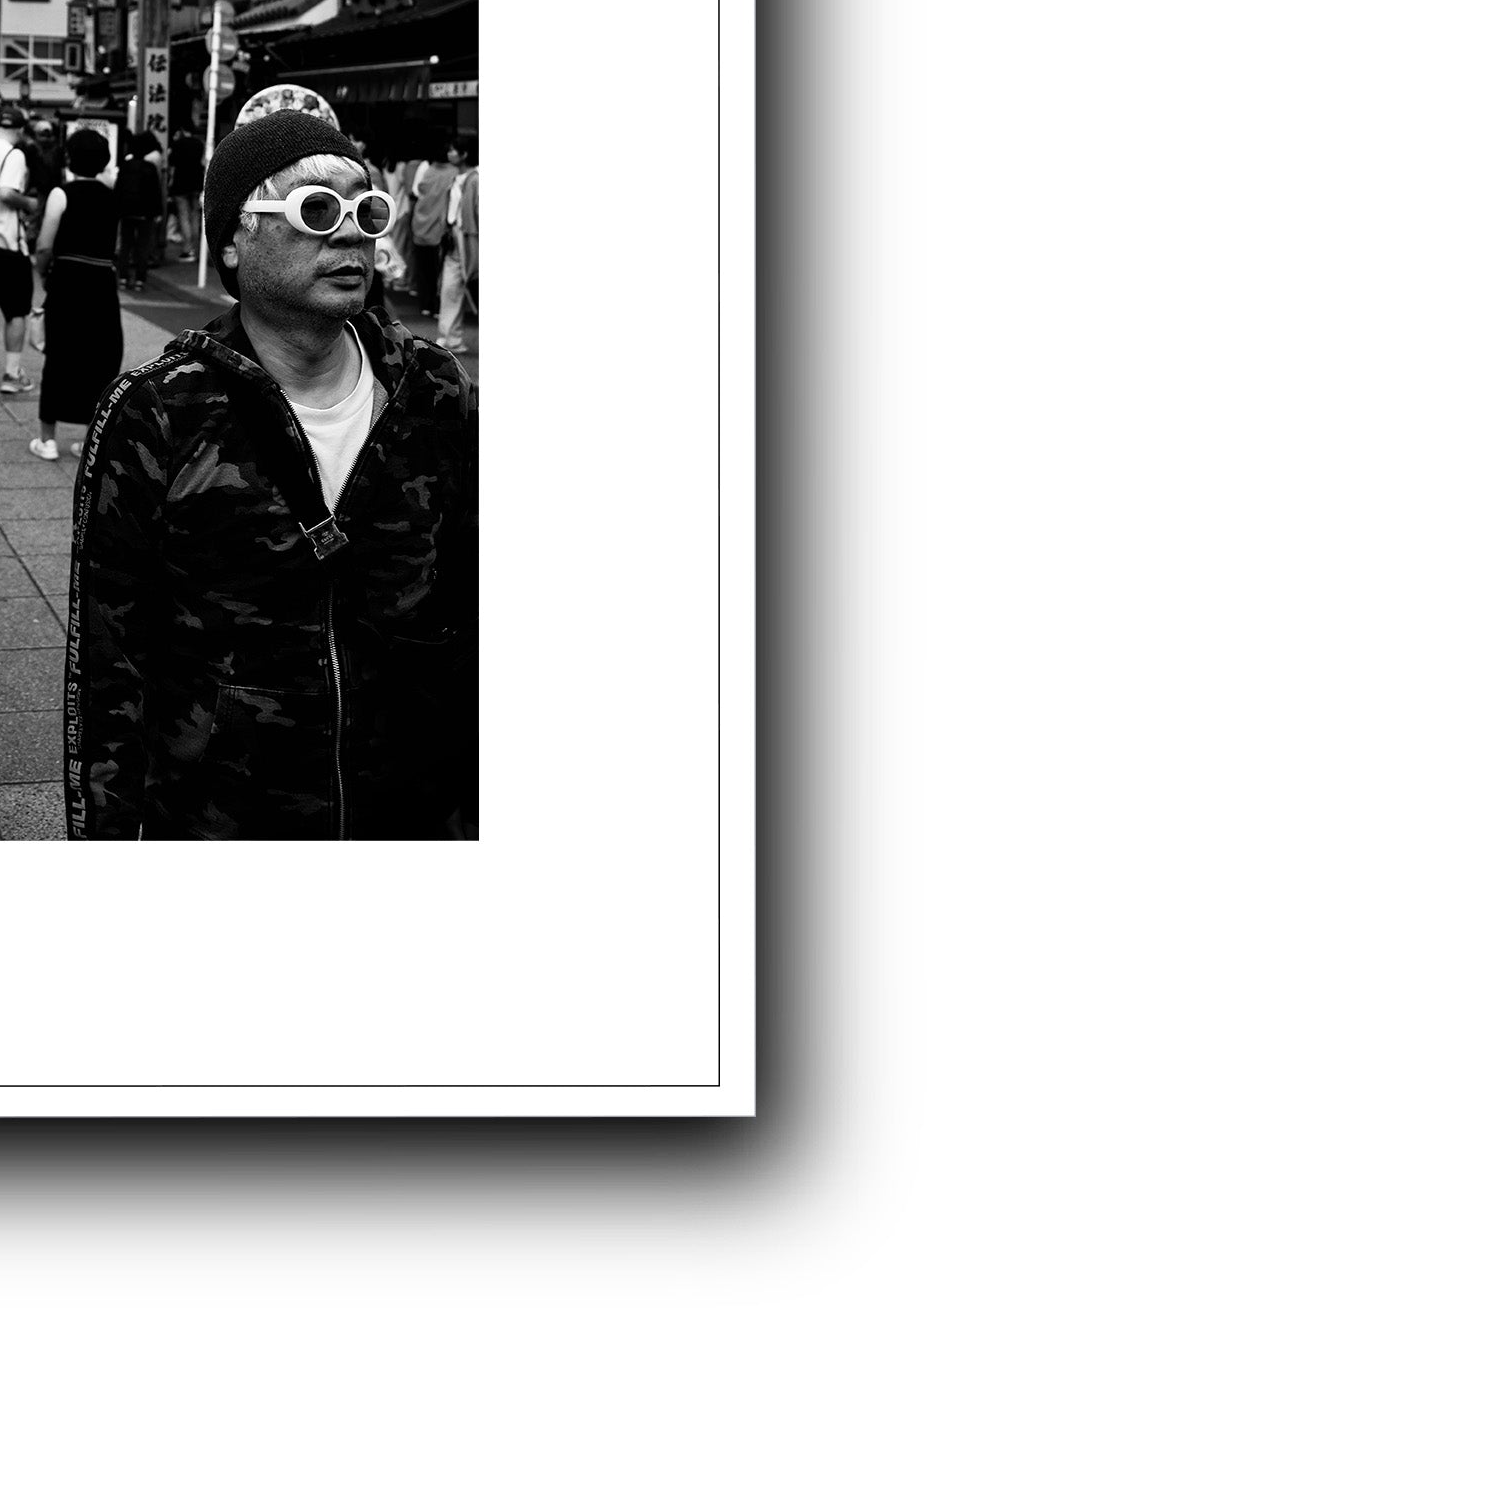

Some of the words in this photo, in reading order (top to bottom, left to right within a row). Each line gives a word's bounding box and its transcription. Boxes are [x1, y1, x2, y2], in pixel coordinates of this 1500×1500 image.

[84, 378, 132, 478] FULFILL-ME
[67, 561, 81, 676] FULFILL-ME
[67, 681, 79, 755] EXPLOITS
